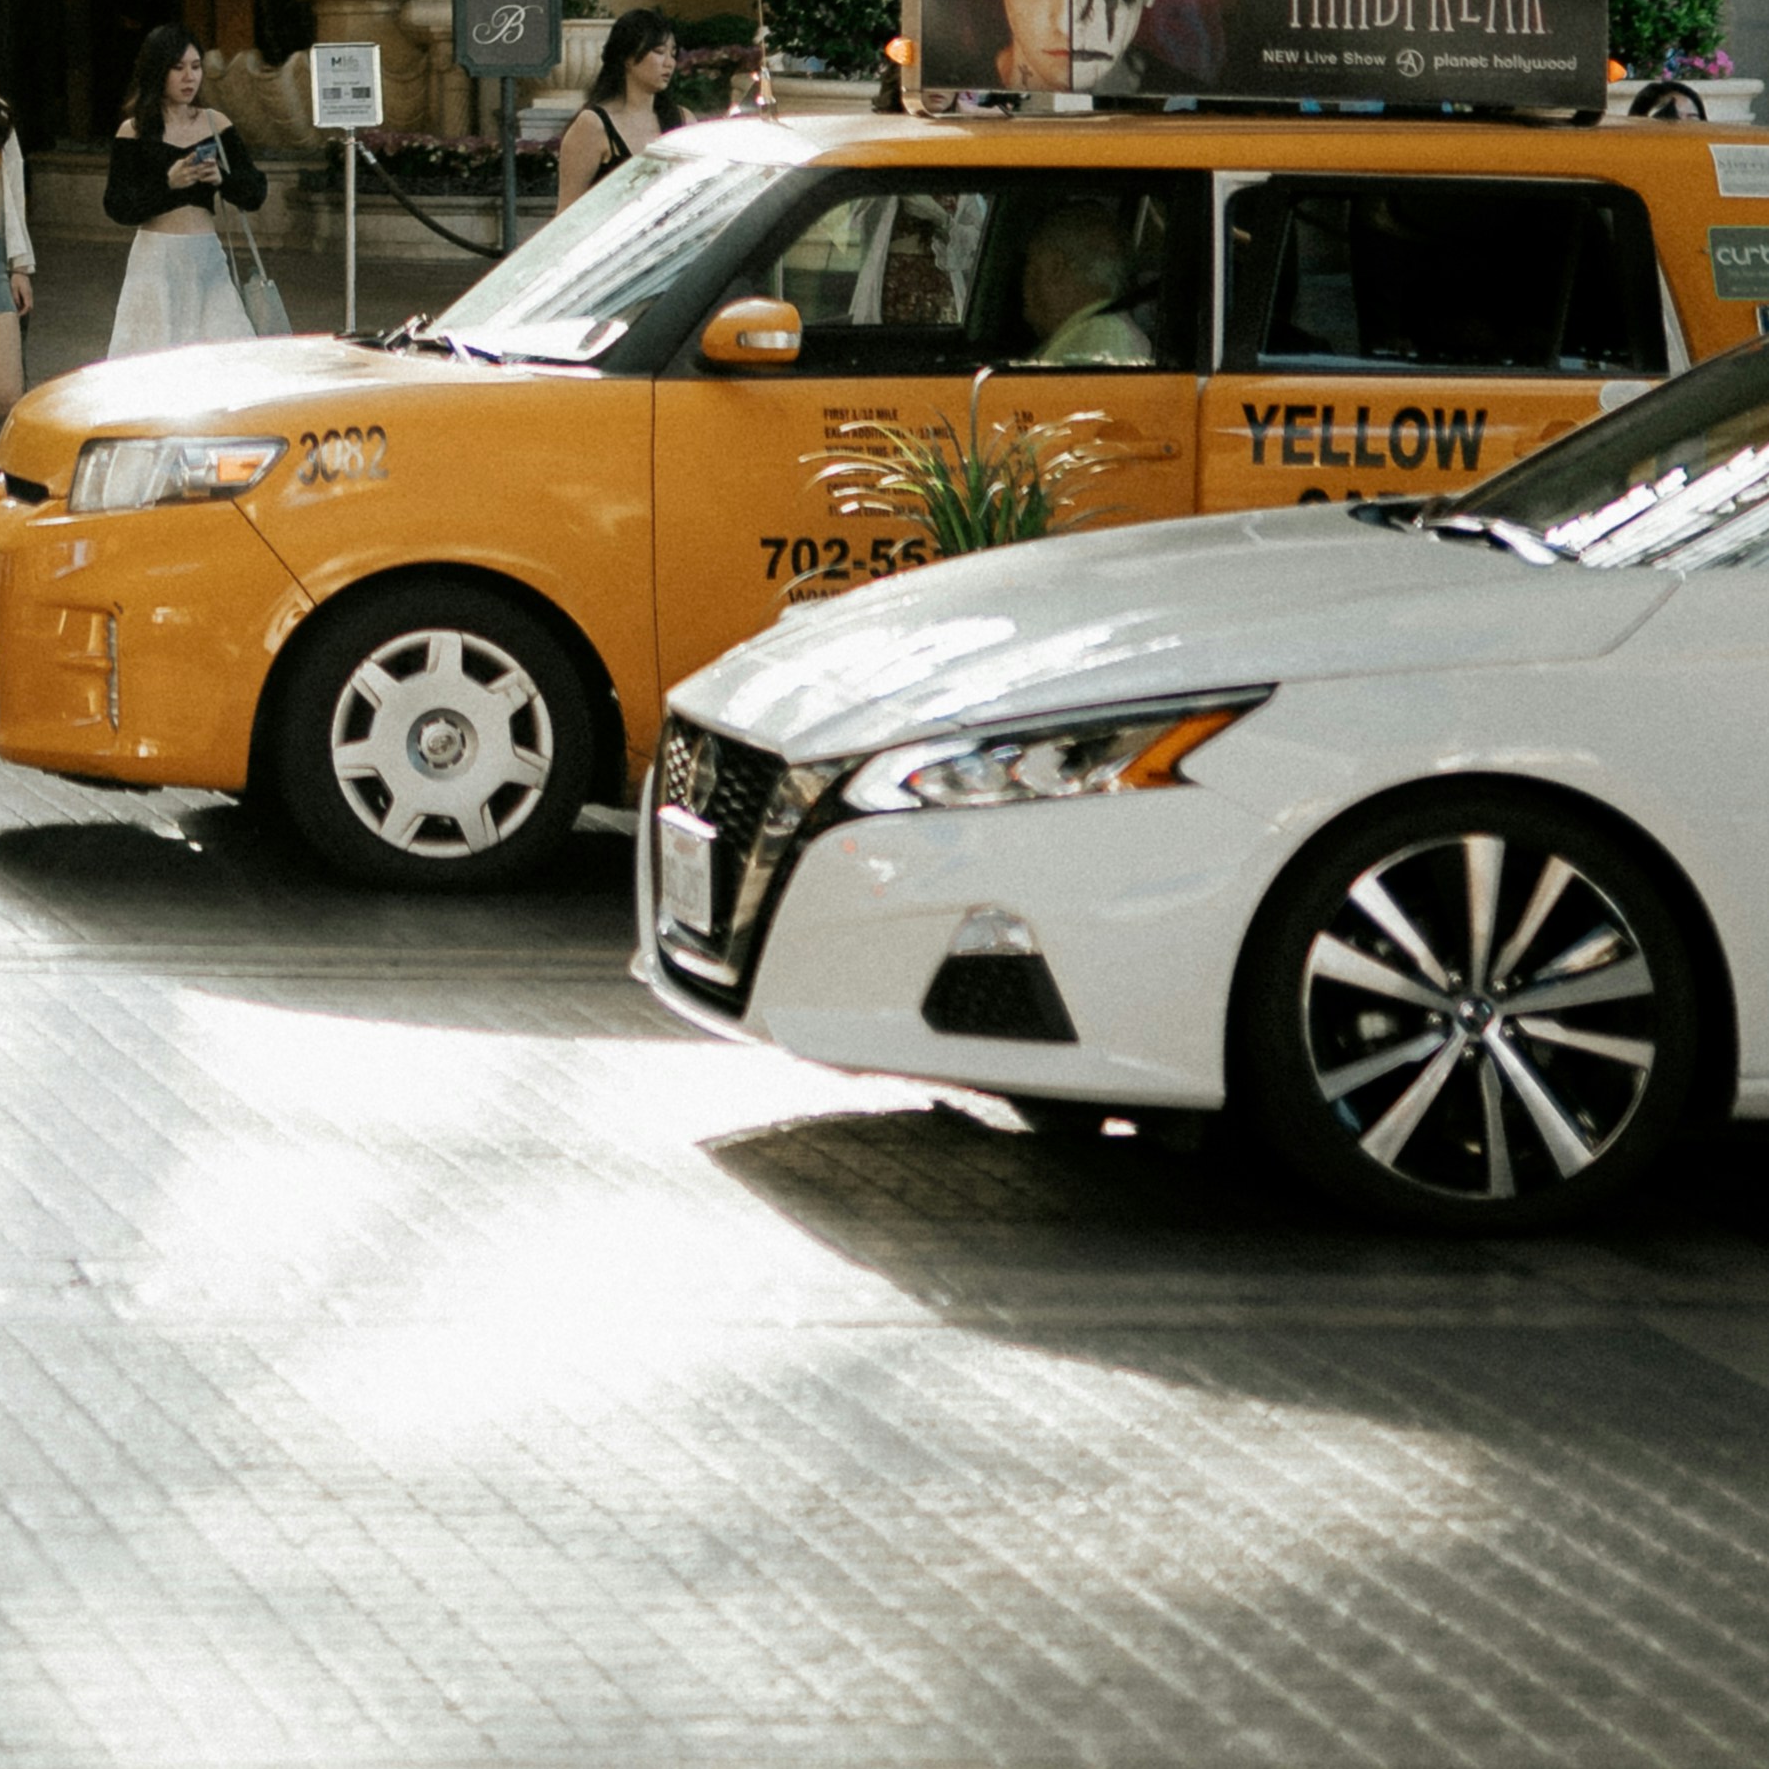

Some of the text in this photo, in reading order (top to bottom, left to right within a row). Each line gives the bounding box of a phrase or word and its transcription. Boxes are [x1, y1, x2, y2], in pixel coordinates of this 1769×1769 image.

[472, 4, 545, 45] B
[1262, 48, 1387, 67] NEW Live Show
[1433, 52, 1578, 74] planet hollywood
[296, 426, 390, 487] 3082
[1242, 402, 1489, 472] YELLOW
